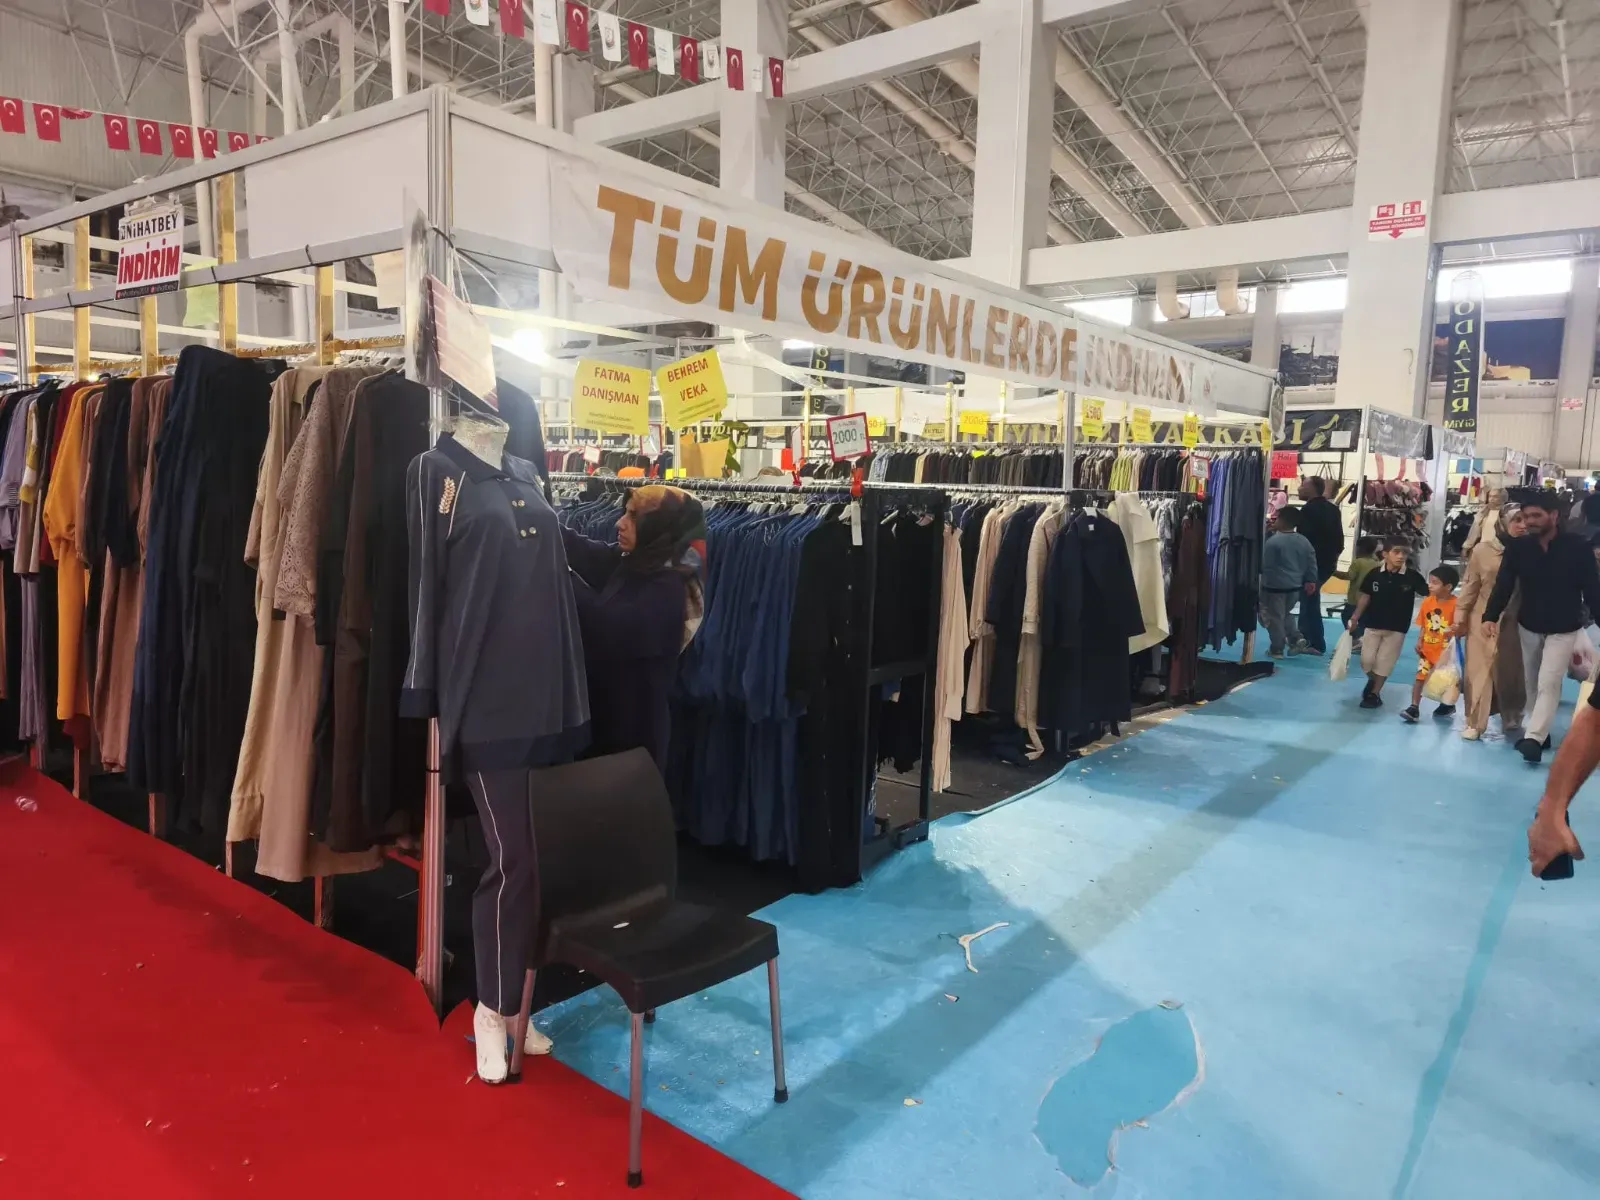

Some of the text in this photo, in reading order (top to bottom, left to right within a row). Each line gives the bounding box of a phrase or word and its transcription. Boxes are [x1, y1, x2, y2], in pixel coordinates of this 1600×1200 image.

[118, 238, 180, 285] İNDİRİM
[597, 184, 787, 321] TÜM
[801, 251, 1078, 382] ÜRÜNLERDE
[594, 367, 631, 384] FATMA
[667, 358, 709, 382] BEHREM
[582, 385, 639, 405] DANIŞMAN
[680, 382, 708, 402] VEKA
[833, 428, 857, 445] 2000
[1372, 581, 1379, 592] 6
